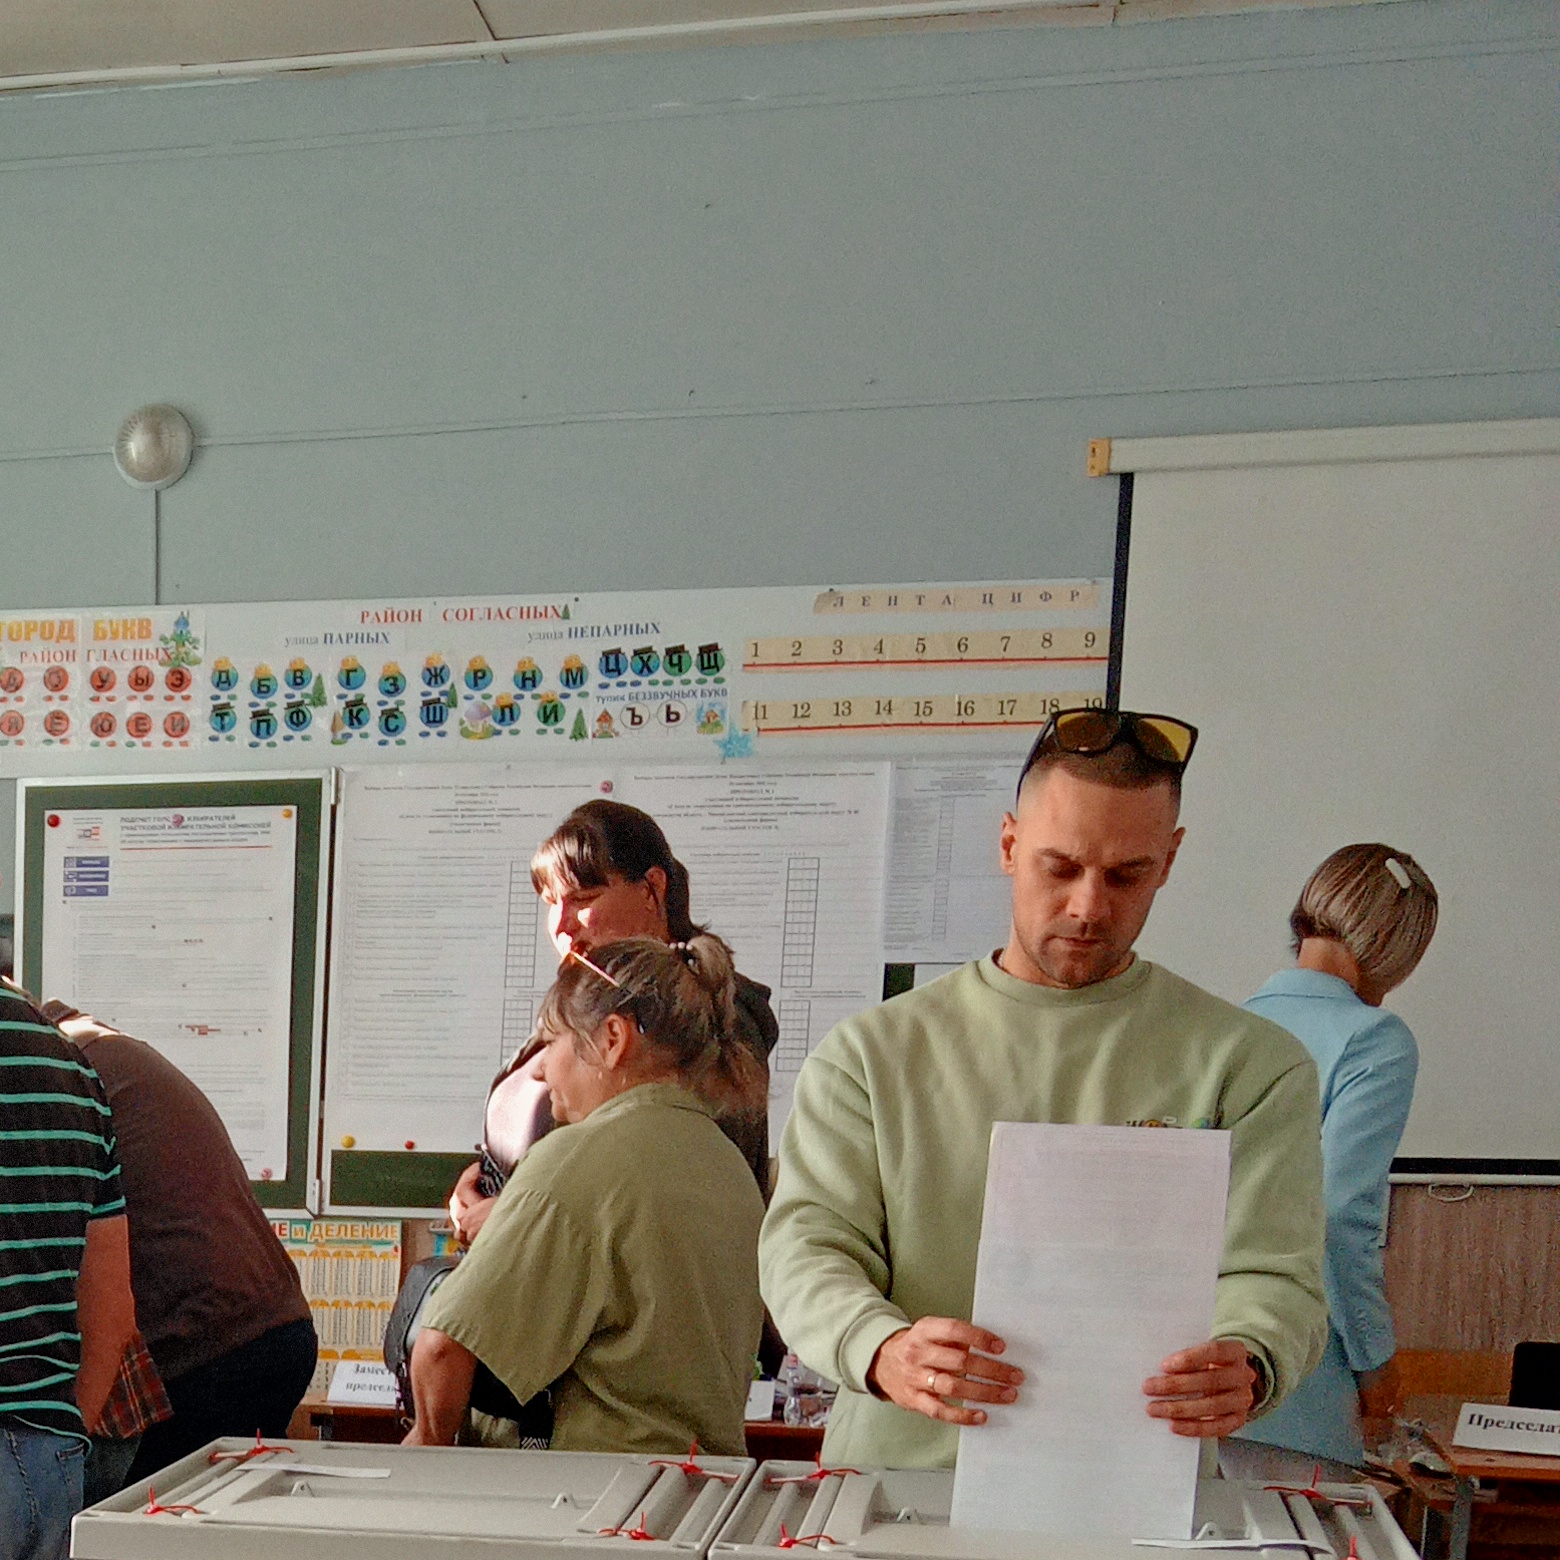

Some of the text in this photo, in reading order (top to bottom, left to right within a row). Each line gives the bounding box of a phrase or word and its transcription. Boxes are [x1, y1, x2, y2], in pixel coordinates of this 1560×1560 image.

[361, 604, 562, 624] РАЙОН СОГЛАСНЫХ
[93, 618, 152, 641] БУКВ
[323, 632, 390, 645] ПАРНЫХ
[568, 622, 661, 639] НЕПАРНЫХ
[19, 647, 173, 664] РАЙОН ГЛАСНЫХ
[752, 632, 1096, 657] 1 2 3 4 5 6 7 8 9
[604, 653, 719, 675] Ц Х Ч Щ
[96, 671, 110, 688] У
[135, 673, 149, 686] Ы
[216, 670, 231, 686] Д
[257, 678, 270, 694] Б
[293, 669, 305, 685] В
[346, 669, 357, 685] Г
[427, 667, 444, 685] Ж
[474, 669, 486, 686] Р
[522, 670, 536, 688] Н
[564, 669, 584, 686] М
[626, 704, 680, 726] Ъ Ь
[752, 697, 1102, 720] 11 12 13 14 15 16 17 18 19
[216, 712, 231, 730] Т
[256, 718, 271, 735] П
[291, 710, 306, 728] Ф
[348, 709, 364, 726] К
[385, 714, 399, 733] С
[426, 706, 443, 724] Ш
[310, 1223, 398, 1241] ДЕЛЕНИЕ
